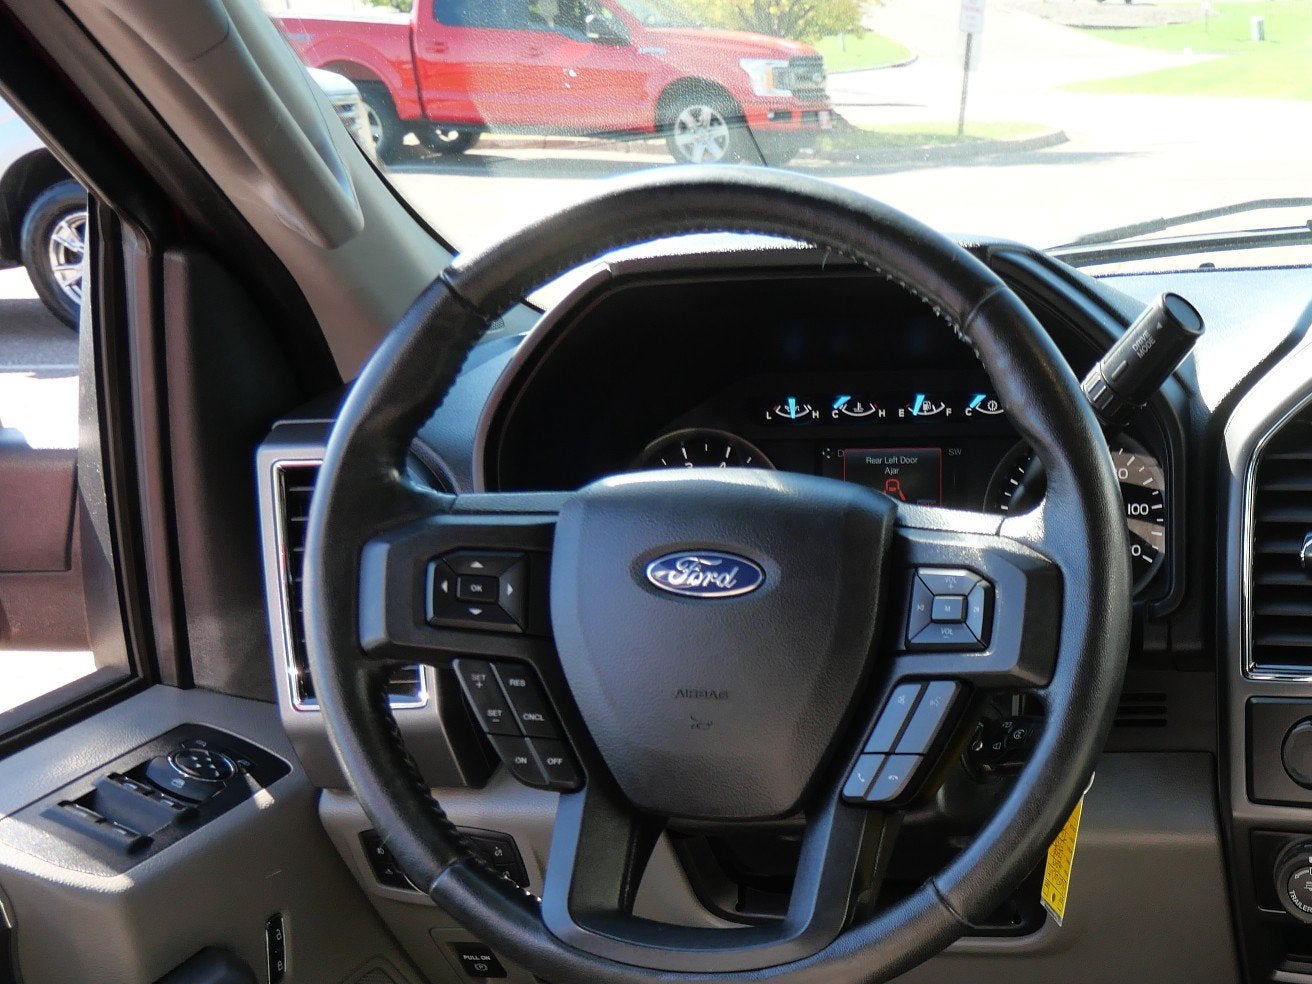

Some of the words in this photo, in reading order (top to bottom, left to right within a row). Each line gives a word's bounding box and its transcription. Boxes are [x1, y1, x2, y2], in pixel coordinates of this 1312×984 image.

[766, 411, 772, 420] L
[812, 411, 819, 419] H
[832, 411, 839, 419] C
[879, 409, 886, 418] H
[898, 409, 905, 418] E
[946, 408, 953, 417] F
[865, 456, 883, 465] Rear
[884, 456, 899, 464] Left
[900, 456, 918, 464] Door
[884, 466, 900, 476] Ajar
[1127, 503, 1149, 515] 100
[656, 555, 740, 589] Ford
[470, 584, 482, 592] OK
[509, 679, 526, 687] RES
[487, 709, 502, 717] SET
[522, 713, 545, 721] CNCL
[515, 756, 528, 765] ON
[547, 758, 563, 766] OFF
[1289, 889, 1312, 913] TRAILER
